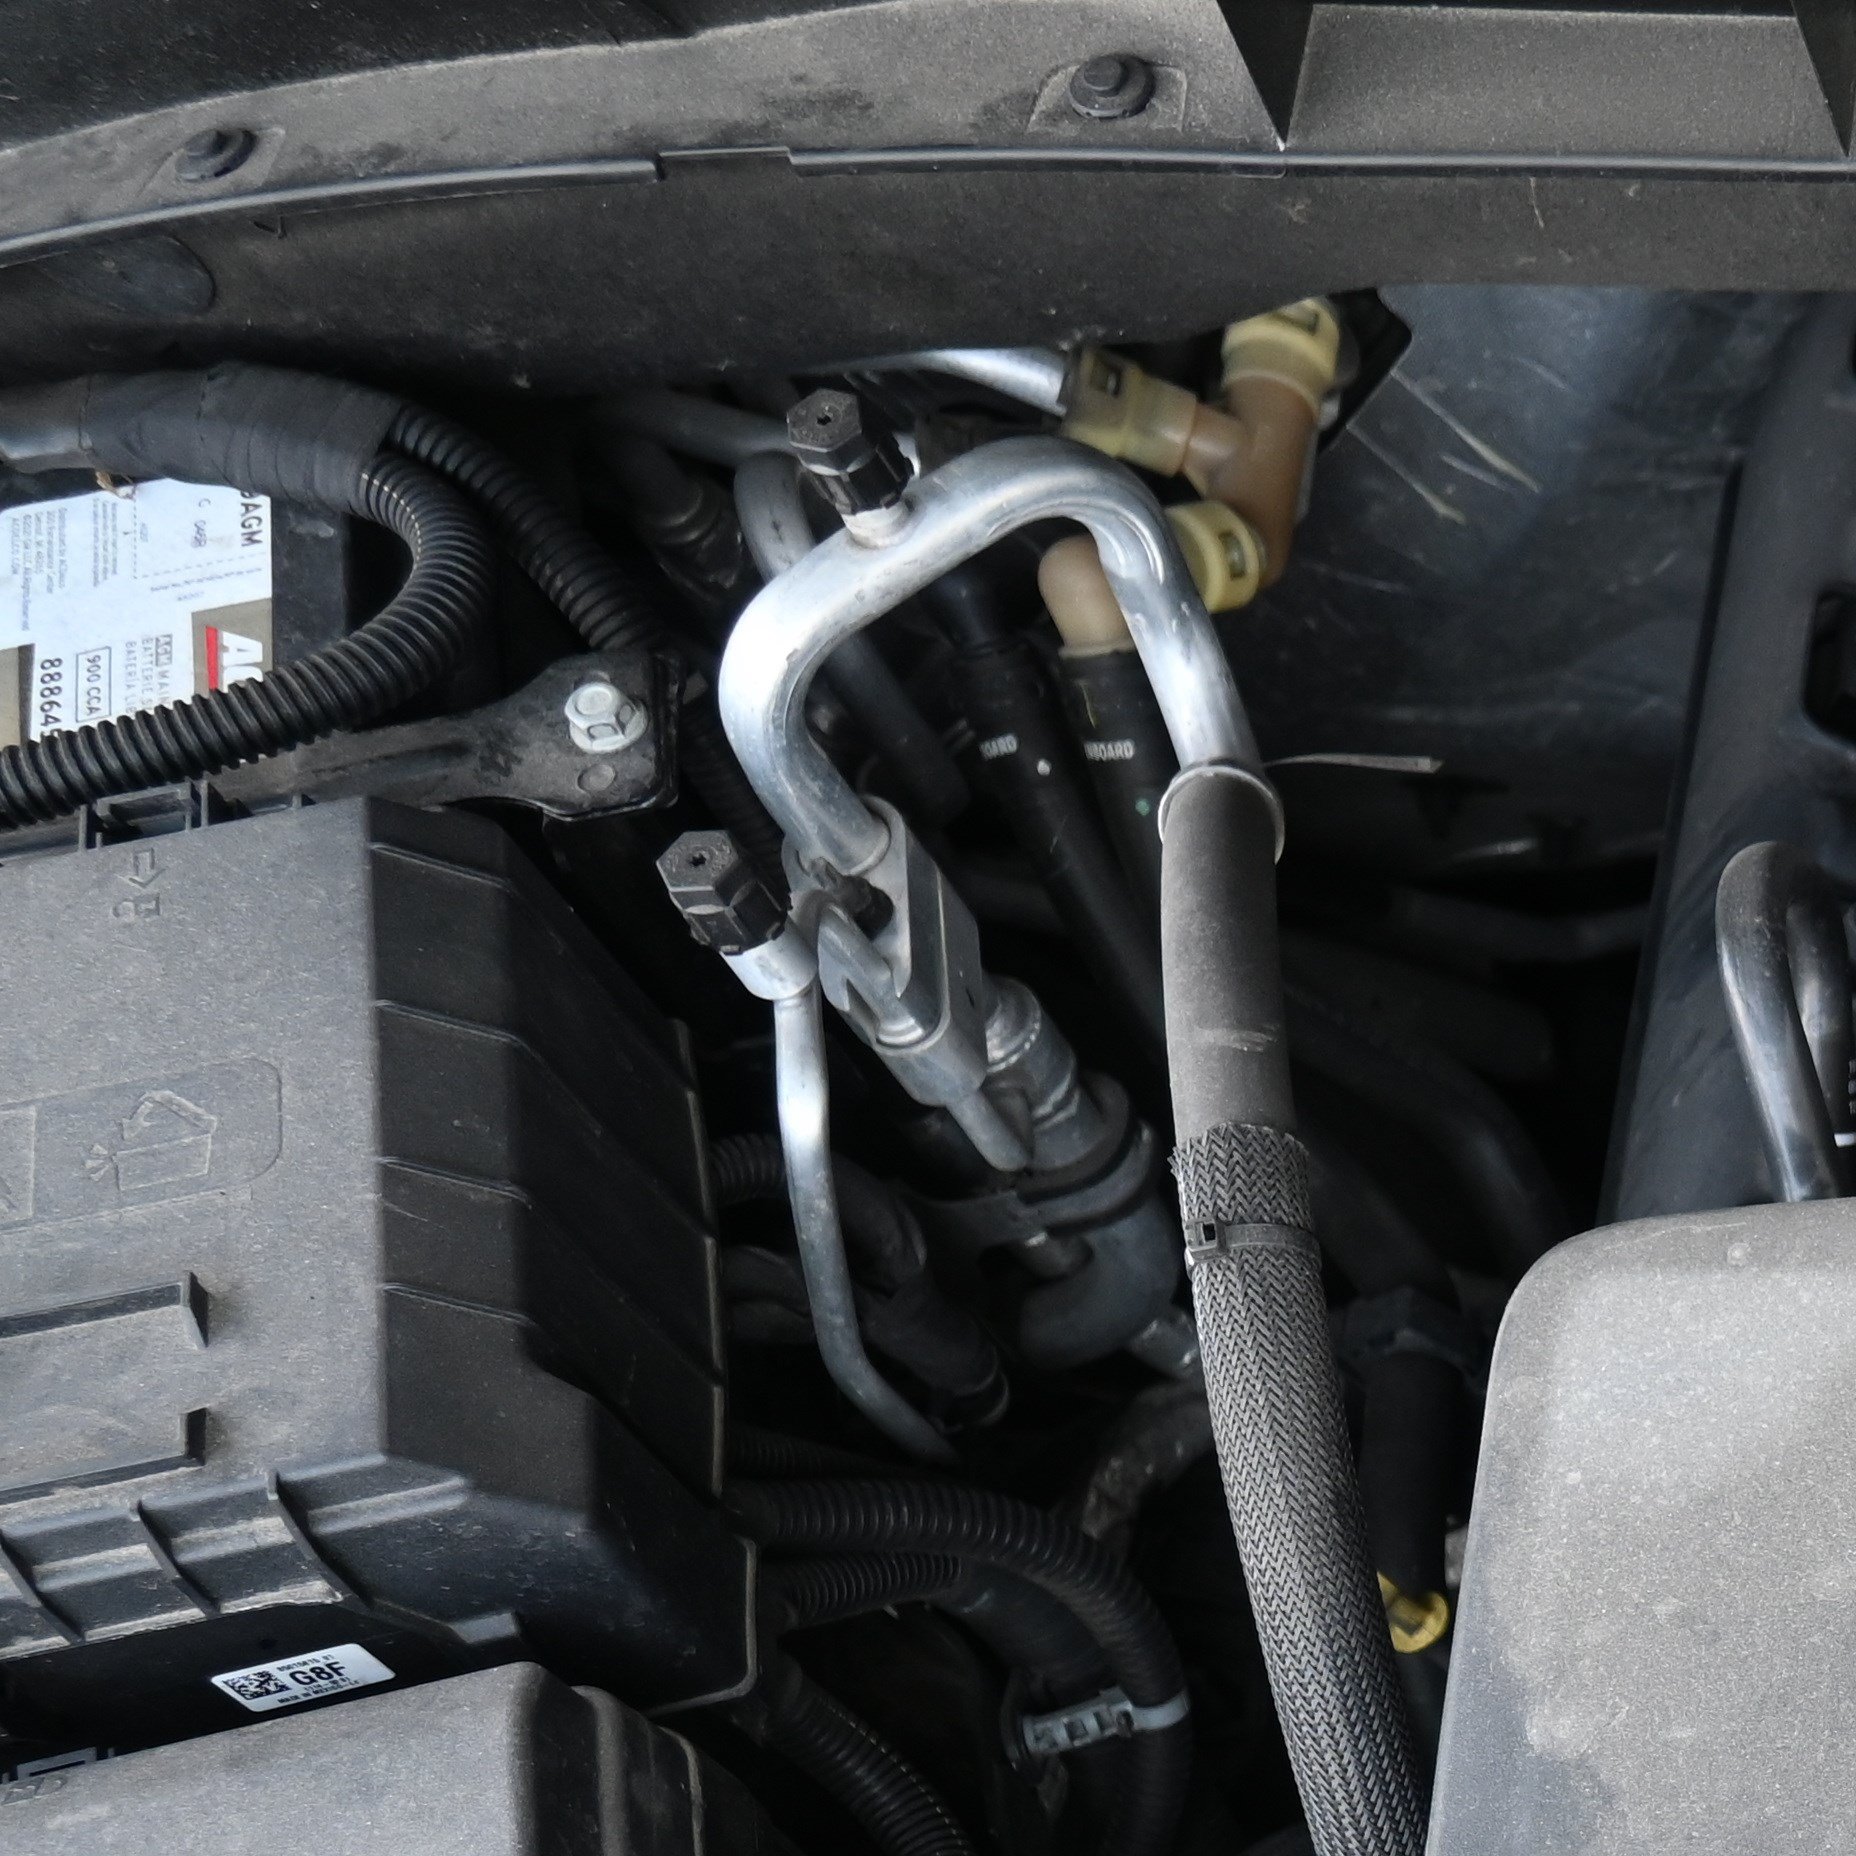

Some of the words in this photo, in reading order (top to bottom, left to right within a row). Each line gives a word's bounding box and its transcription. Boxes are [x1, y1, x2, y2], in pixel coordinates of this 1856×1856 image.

[86, 655, 102, 684] 900
[86, 687, 101, 715] CCA
[289, 1661, 347, 1686] G8F
